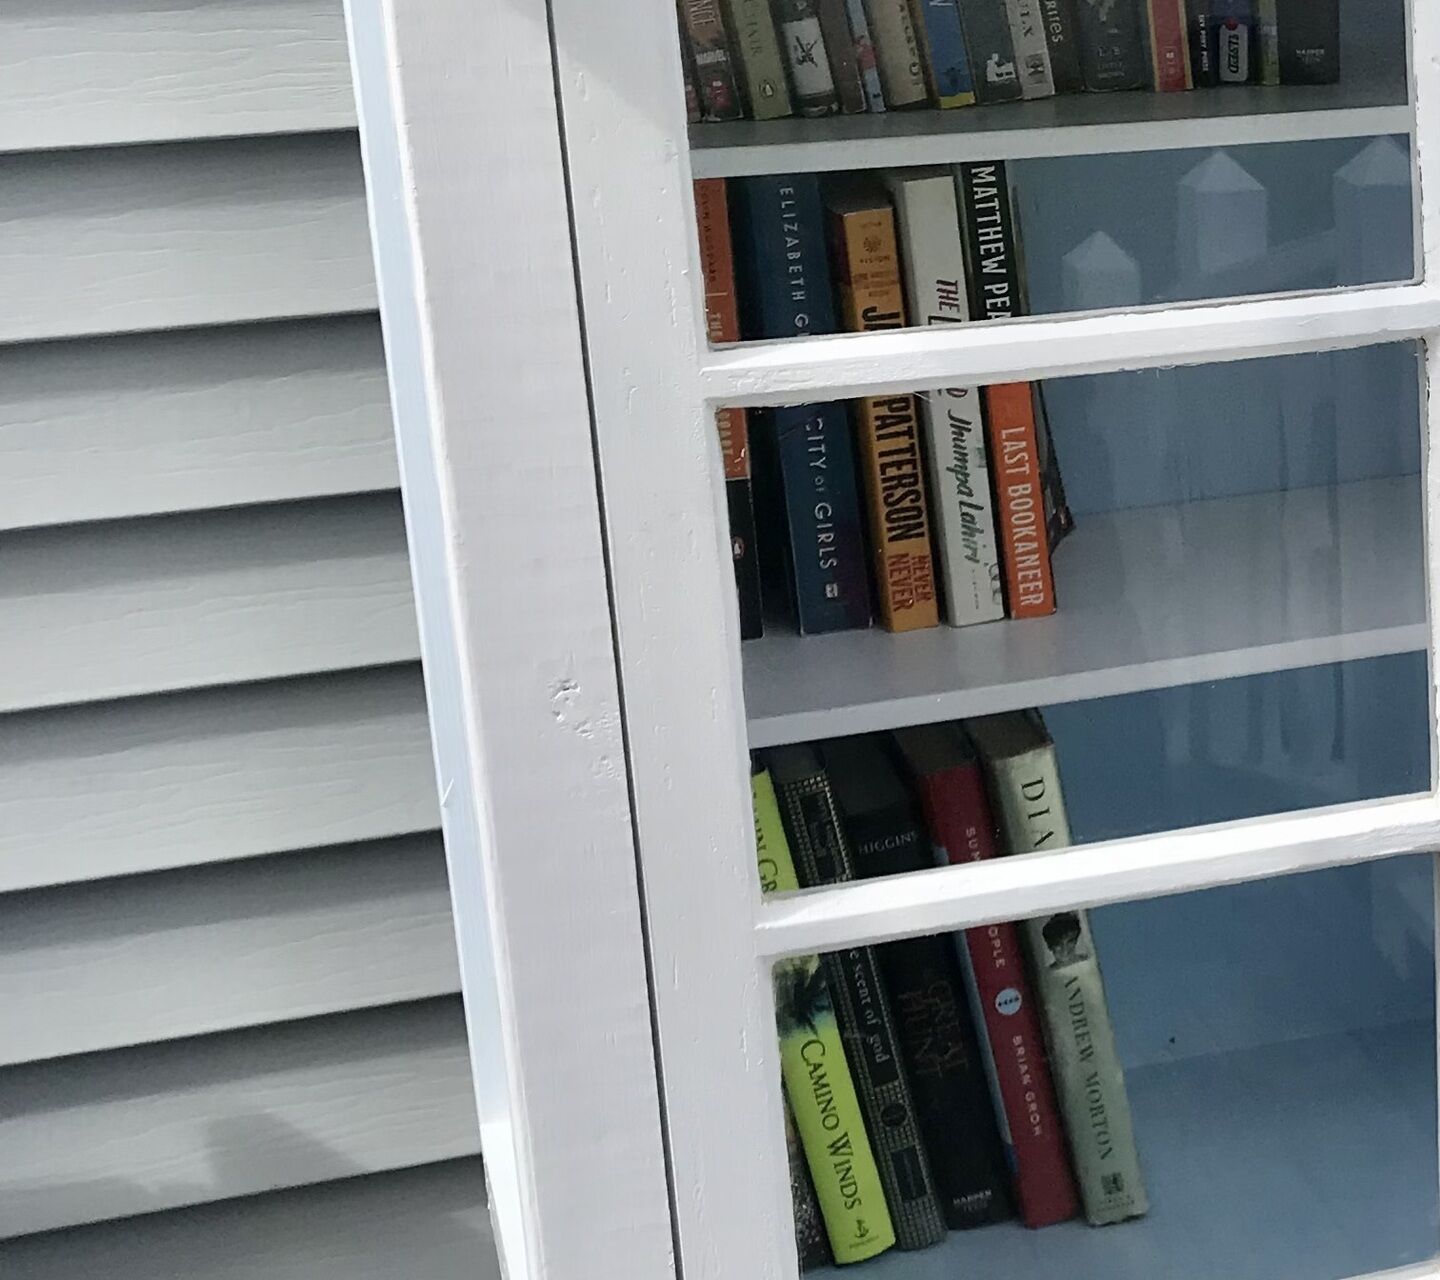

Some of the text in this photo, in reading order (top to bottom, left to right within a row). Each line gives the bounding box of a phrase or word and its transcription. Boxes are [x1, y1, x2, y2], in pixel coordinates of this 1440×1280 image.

[1227, 33, 1241, 74] USED
[779, 187, 806, 301] ELIZABETH
[971, 165, 1012, 320] MATTHEW PEA
[936, 279, 960, 313] THE
[805, 418, 827, 469] CITY
[873, 397, 925, 543] PATTERSON
[946, 409, 973, 499] Jhumpa
[814, 502, 838, 570] GIRLS
[958, 500, 986, 565] Lahiri
[1000, 426, 1045, 607] LAST BOOKANEER
[988, 927, 1005, 968] OPLE
[1012, 1035, 1031, 1084] BRIAN
[1064, 975, 1113, 1160] ANDREW MORTON
[800, 1040, 862, 1210] CAMINO WINDS
